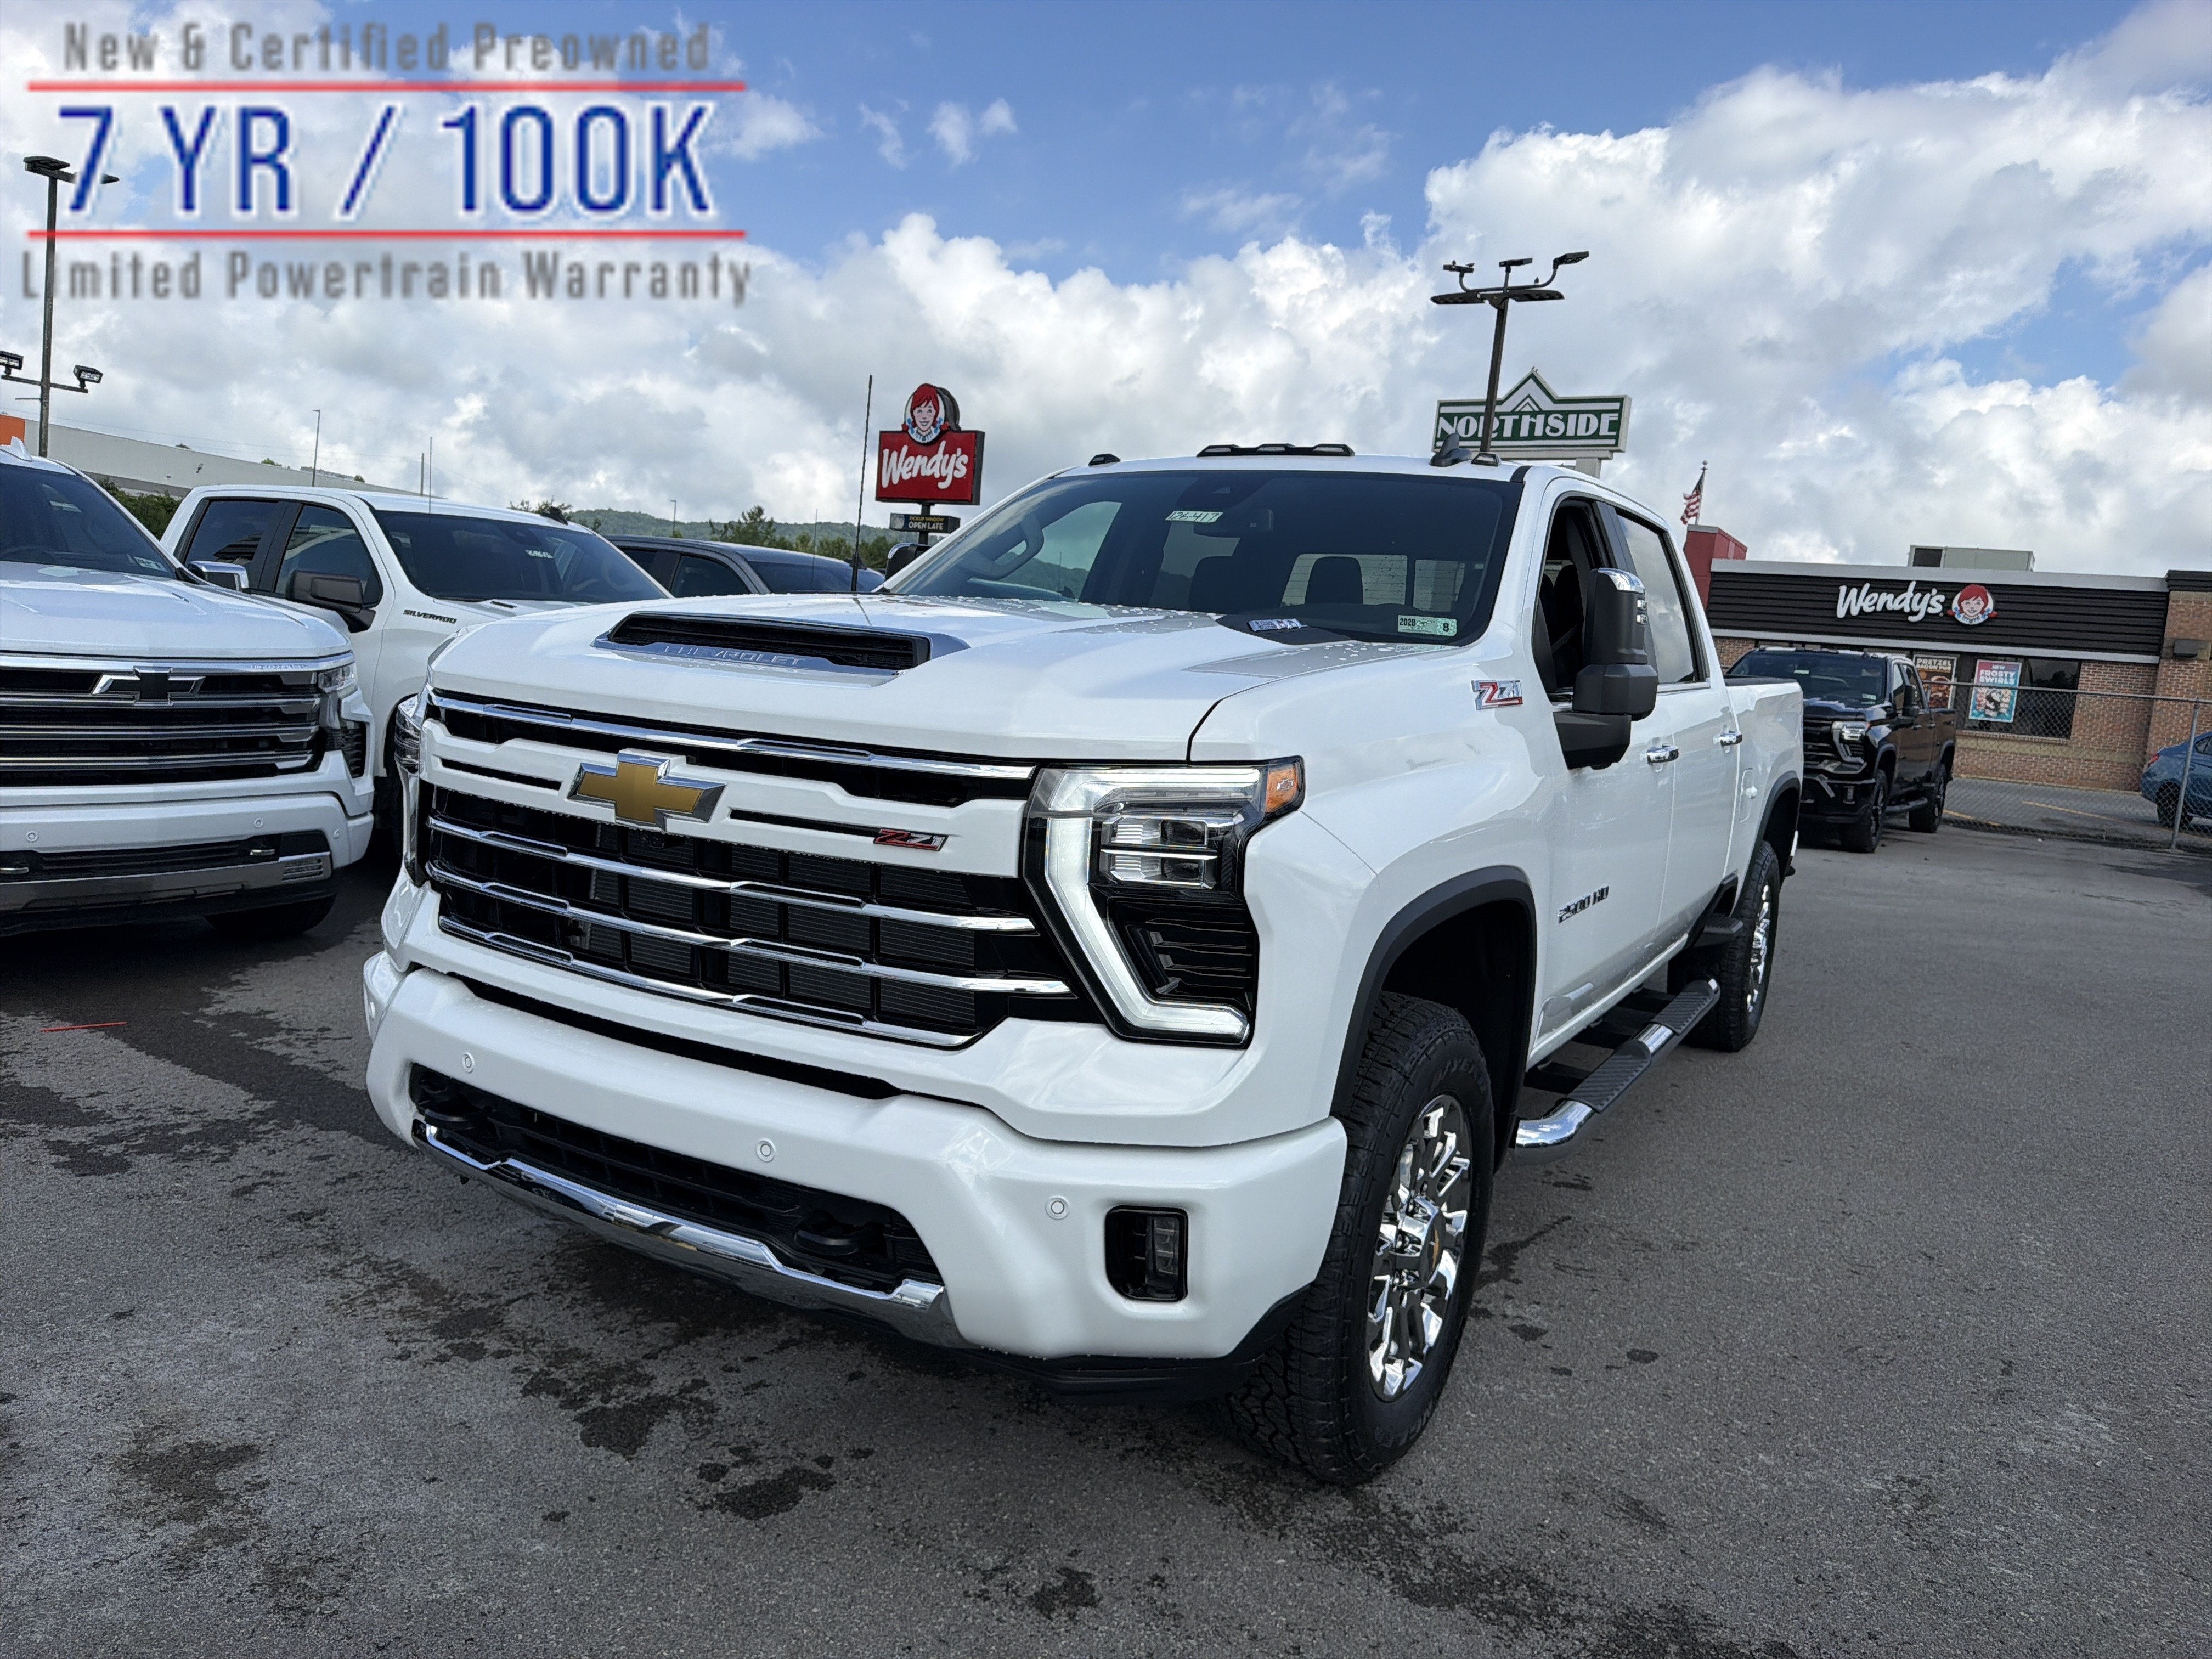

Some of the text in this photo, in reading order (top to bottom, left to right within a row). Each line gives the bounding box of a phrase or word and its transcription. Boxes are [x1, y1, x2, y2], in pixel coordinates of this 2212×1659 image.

[881, 439, 969, 489] Wendy's
[908, 521, 944, 531] OPEN LATE
[1836, 580, 1946, 622] Wendy's
[403, 609, 458, 624] SILVERADO
[1400, 618, 1416, 627] 2028
[1443, 623, 1449, 633] 8
[1979, 669, 2016, 678] FROSTY
[1979, 676, 2015, 685] SWIRLS
